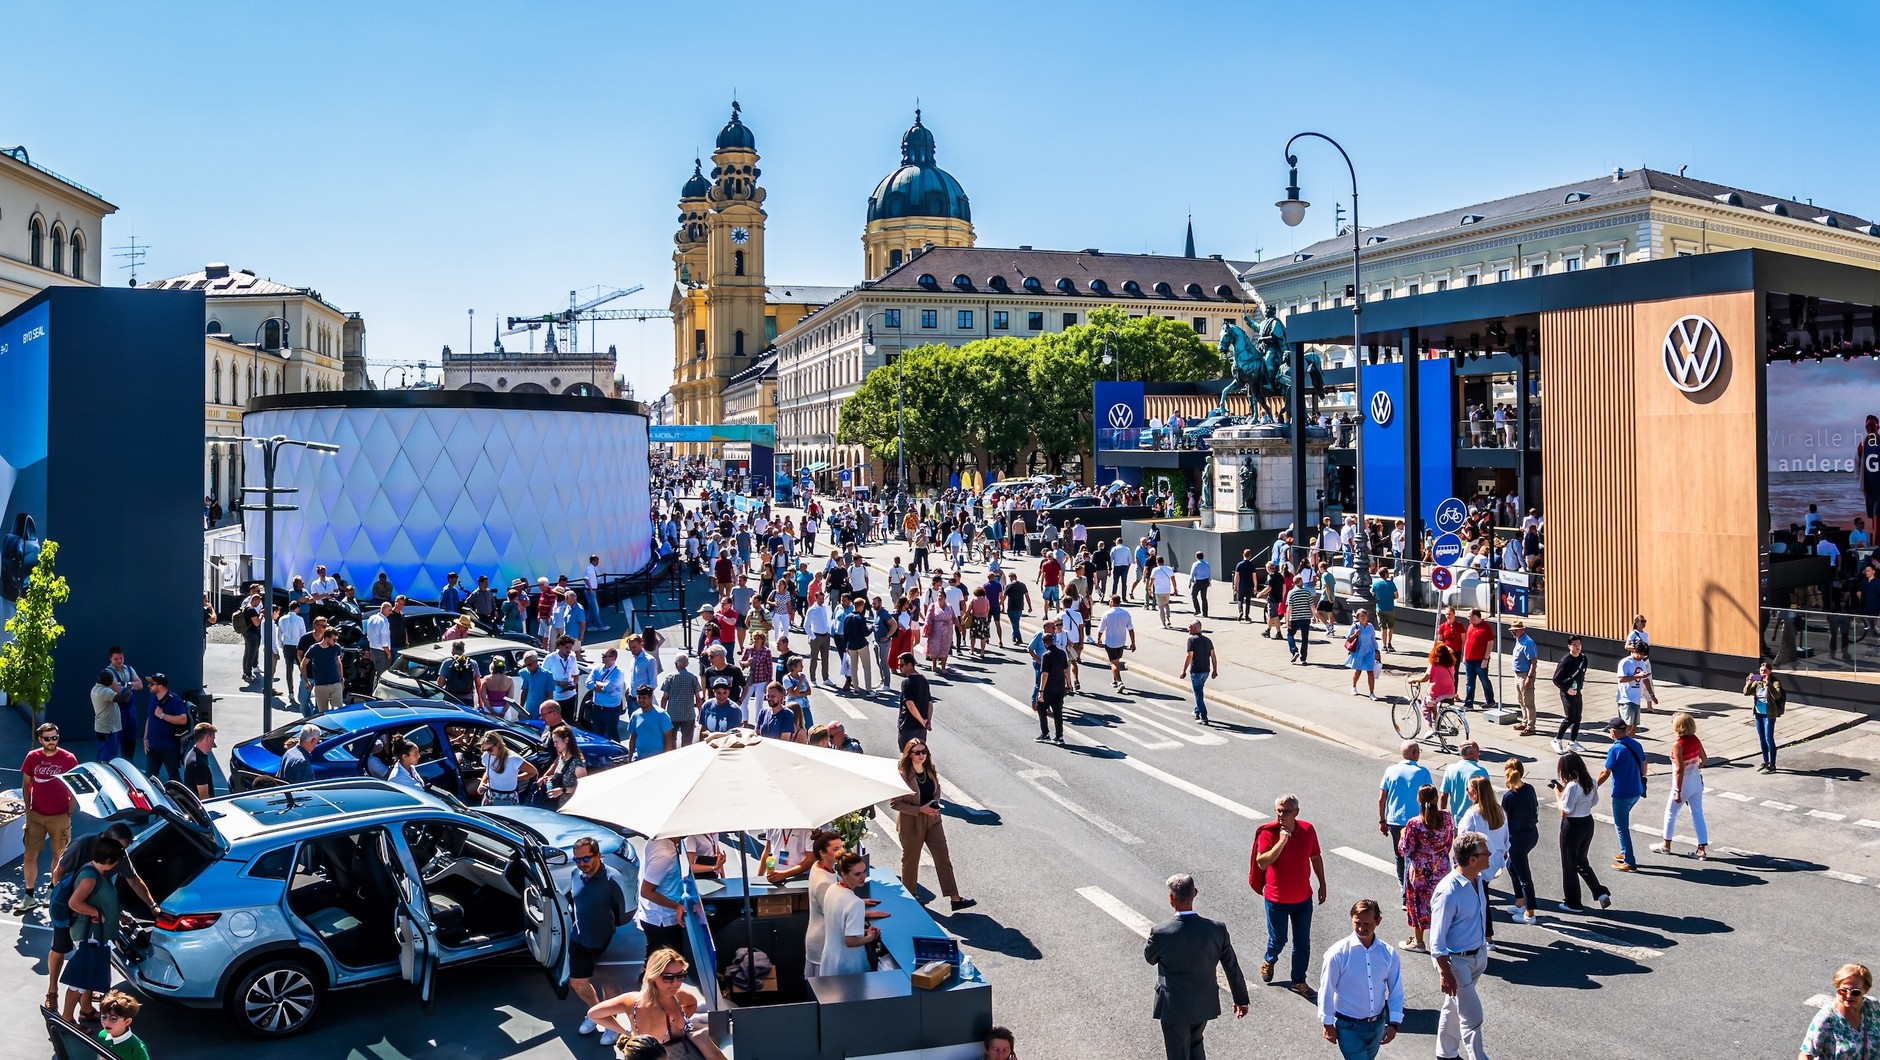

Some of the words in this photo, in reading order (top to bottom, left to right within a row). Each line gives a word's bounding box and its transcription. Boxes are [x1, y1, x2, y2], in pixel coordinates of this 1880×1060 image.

[23, 331, 32, 344] BYD
[33, 326, 45, 339] SEAL
[1804, 428, 1842, 447] alle
[1854, 428, 1878, 447] ha
[1779, 453, 1855, 472] andere
[1865, 453, 1880, 473] G
[1519, 595, 1525, 614] 1
